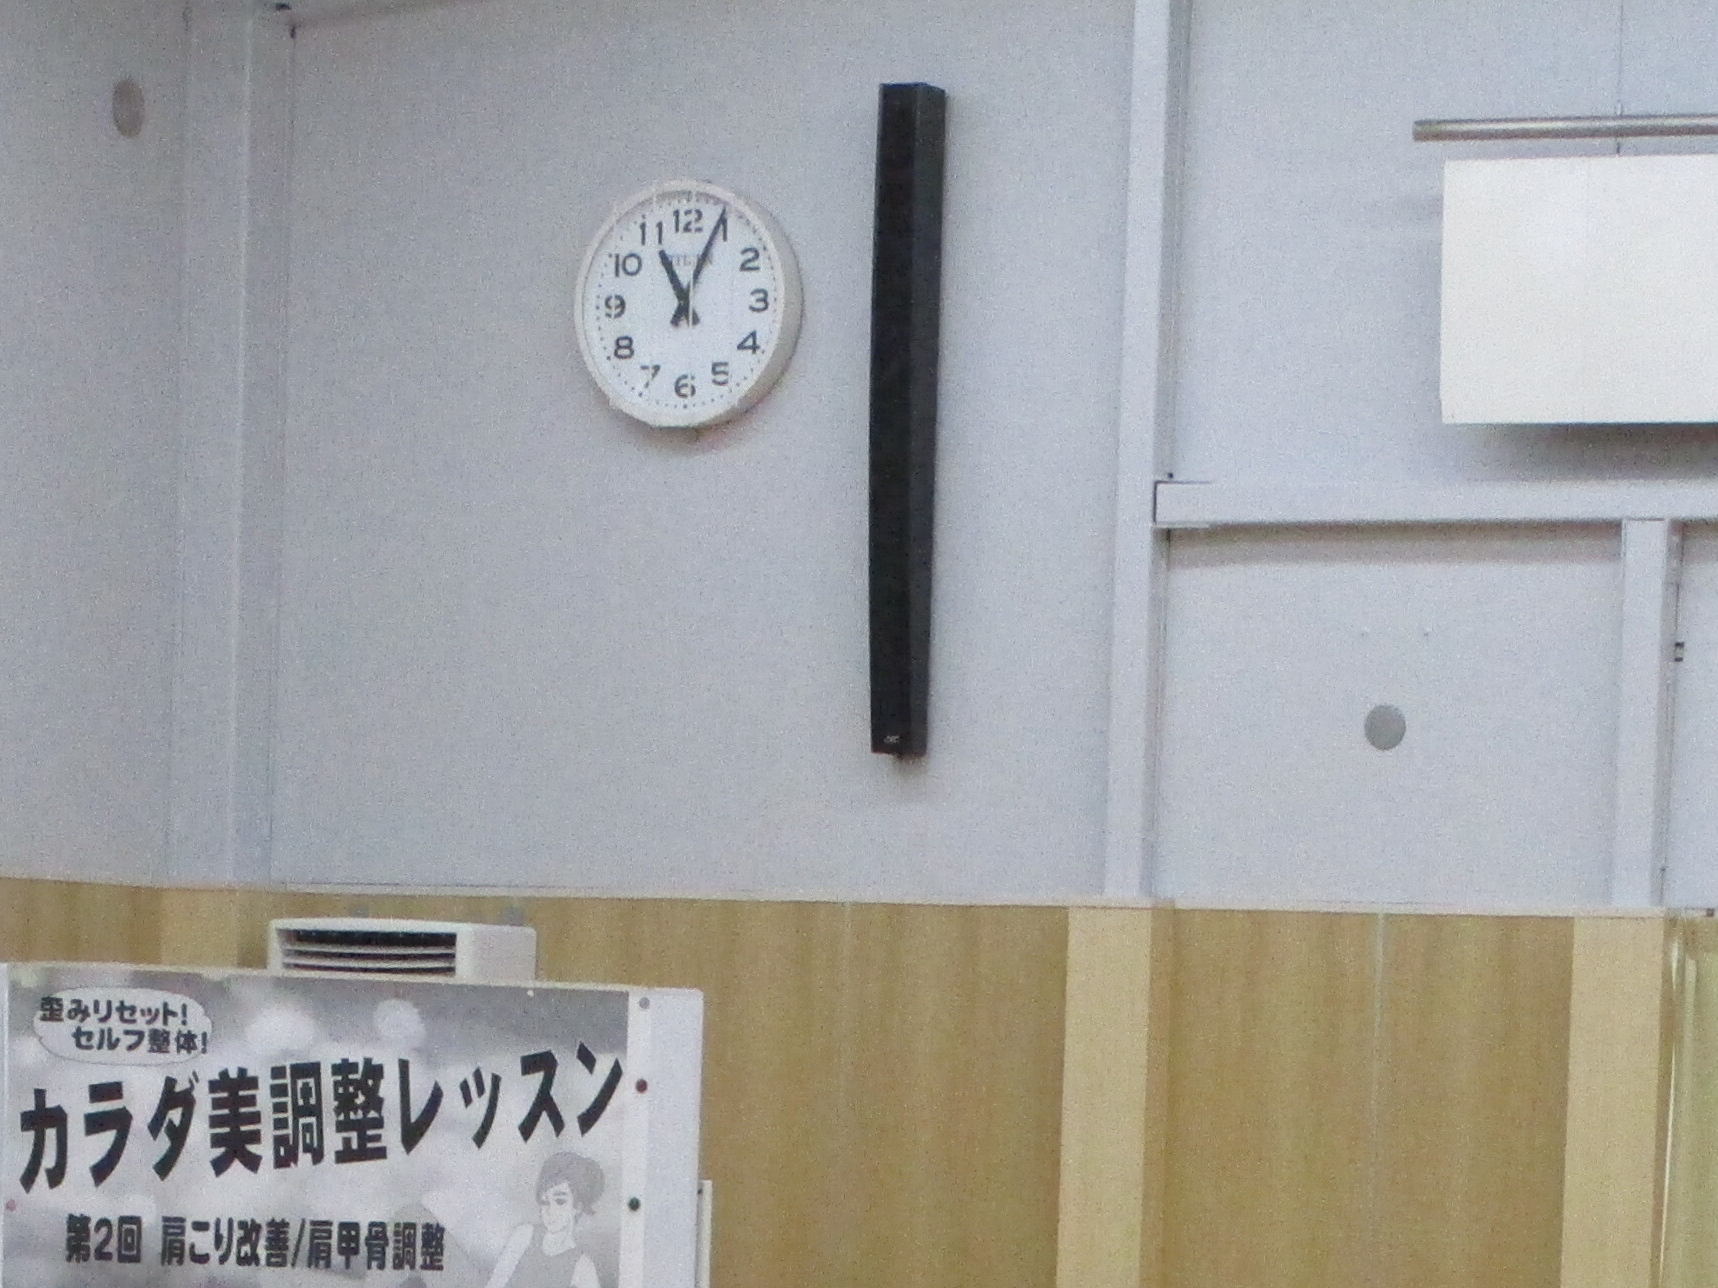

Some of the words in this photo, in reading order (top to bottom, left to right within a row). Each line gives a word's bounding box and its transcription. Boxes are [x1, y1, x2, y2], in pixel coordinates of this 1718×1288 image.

[640, 220, 664, 246] 11
[672, 208, 704, 233] 12
[614, 253, 642, 277] 10
[739, 247, 761, 272] 2
[604, 294, 626, 319] 9
[749, 288, 770, 313] 3
[614, 336, 634, 360] 8
[737, 330, 761, 355] 4
[640, 364, 661, 389] 7
[711, 361, 729, 386] 5
[674, 374, 696, 399] 6
[19, 1040, 623, 1194] カラダ美調整レッスン
[65, 1213, 142, 1264] 第2回
